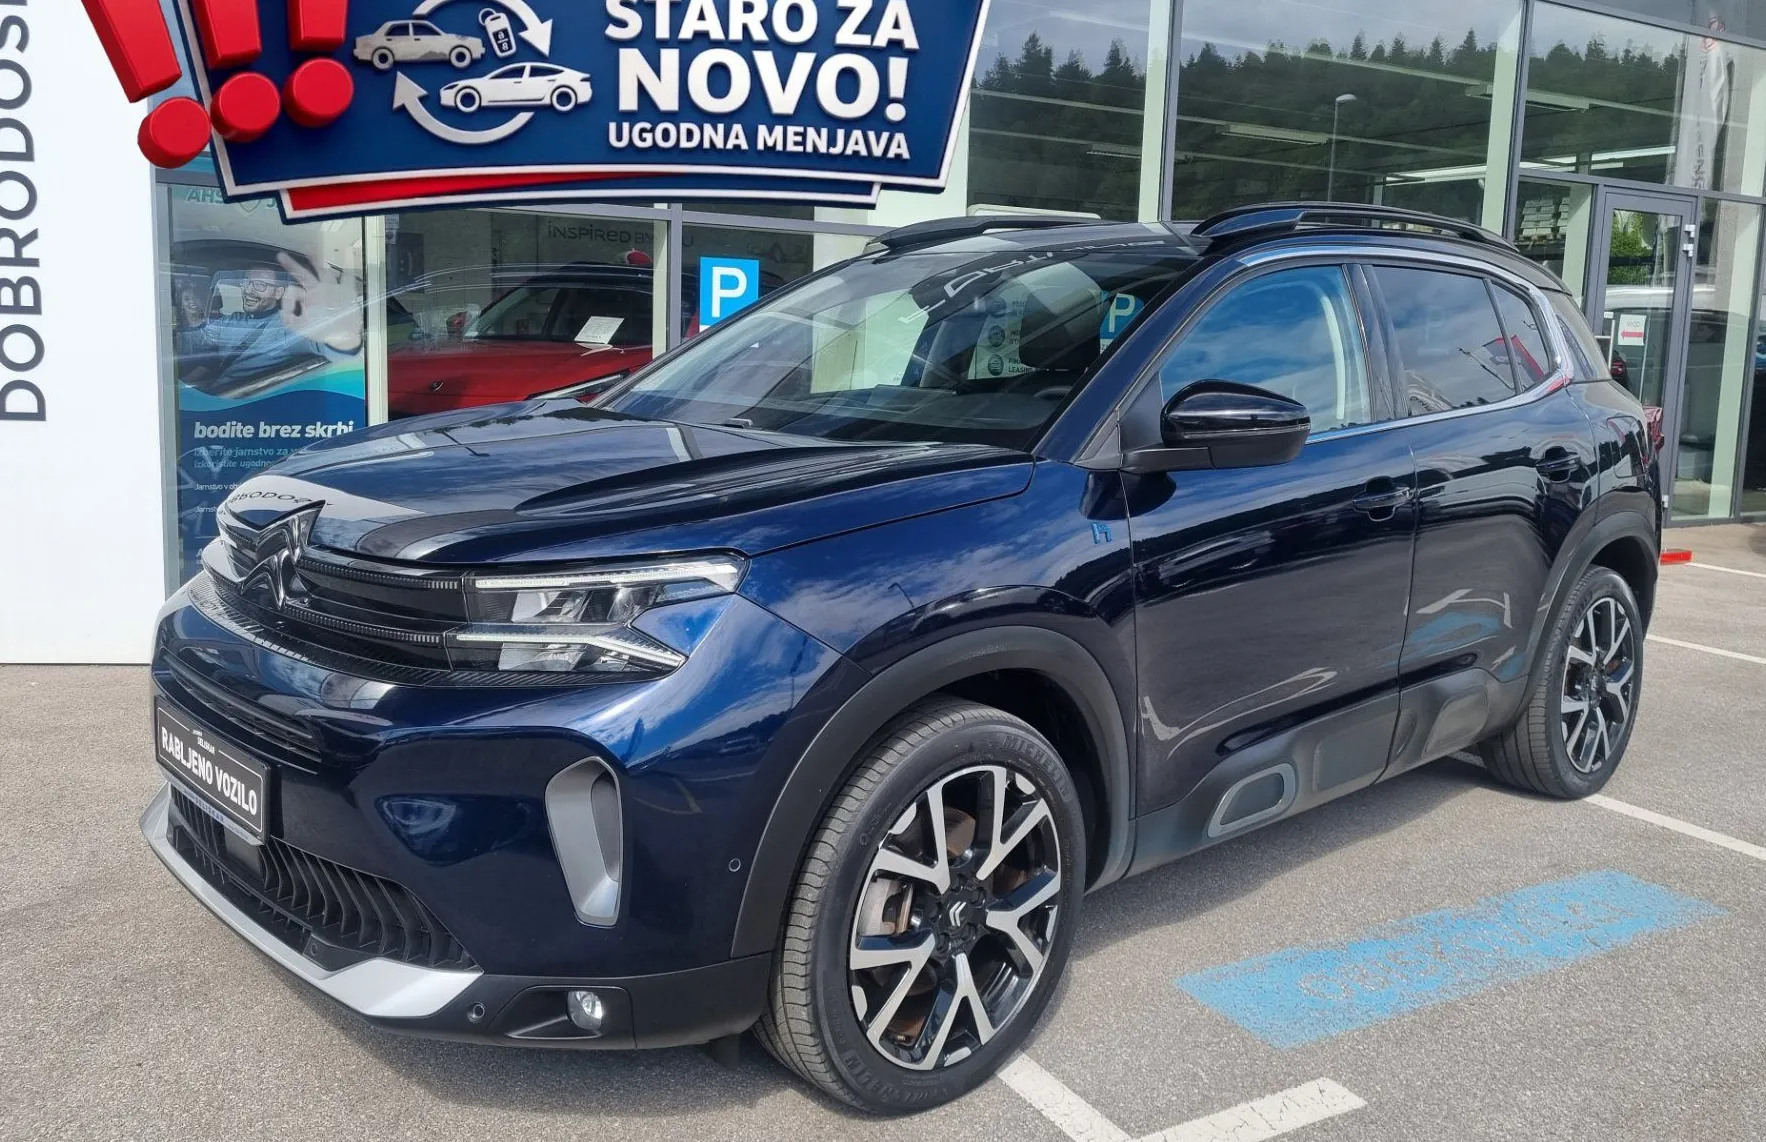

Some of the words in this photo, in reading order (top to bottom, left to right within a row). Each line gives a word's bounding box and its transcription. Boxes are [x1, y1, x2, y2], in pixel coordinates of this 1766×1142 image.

[0, 0, 46, 421] DOBRODOS
[711, 266, 747, 318] P
[1108, 293, 1135, 333] P
[194, 421, 255, 438] bodite
[258, 422, 301, 438] brez
[234, 446, 274, 457] jamstvo
[276, 448, 288, 456] za
[161, 727, 213, 785] RABLJENO
[215, 766, 257, 815] VOZILO
